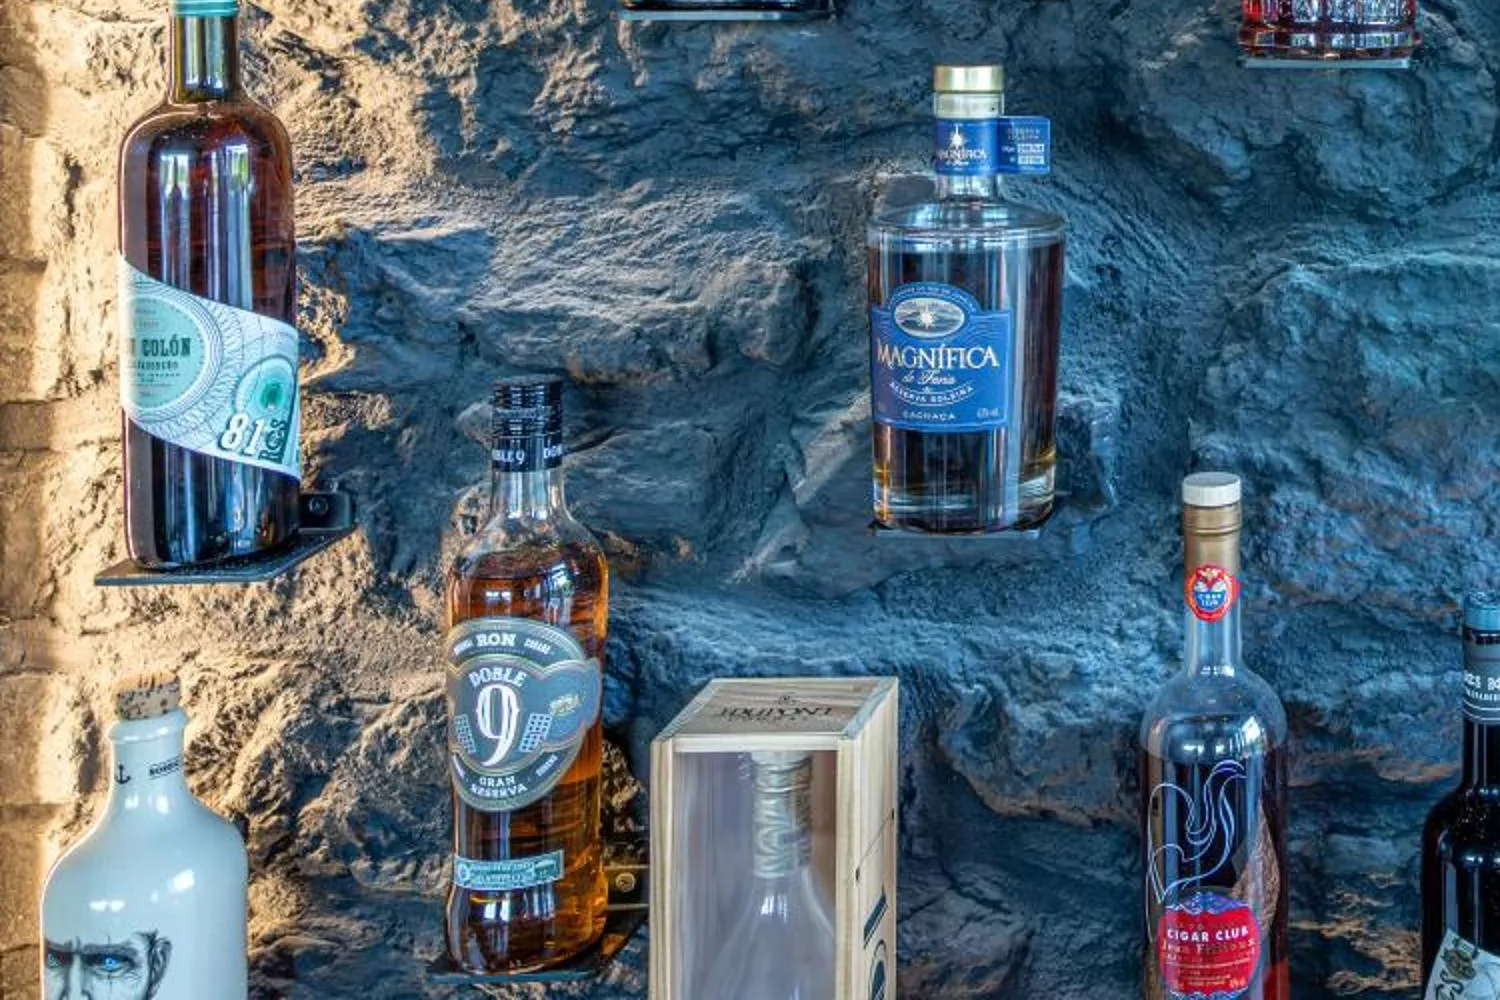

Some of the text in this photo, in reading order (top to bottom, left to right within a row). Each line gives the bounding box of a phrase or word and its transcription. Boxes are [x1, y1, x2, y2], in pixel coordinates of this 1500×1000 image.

[142, 333, 193, 358] COLÓN
[876, 338, 1000, 370] MAGNÍFICA
[219, 411, 266, 458] 81
[474, 632, 517, 648] RON
[468, 667, 529, 689] DOBLE
[476, 683, 519, 768] 9
[470, 783, 528, 798] RESERVA
[478, 775, 516, 787] GRAN
[1166, 926, 1250, 943] CIGAR CLUB
